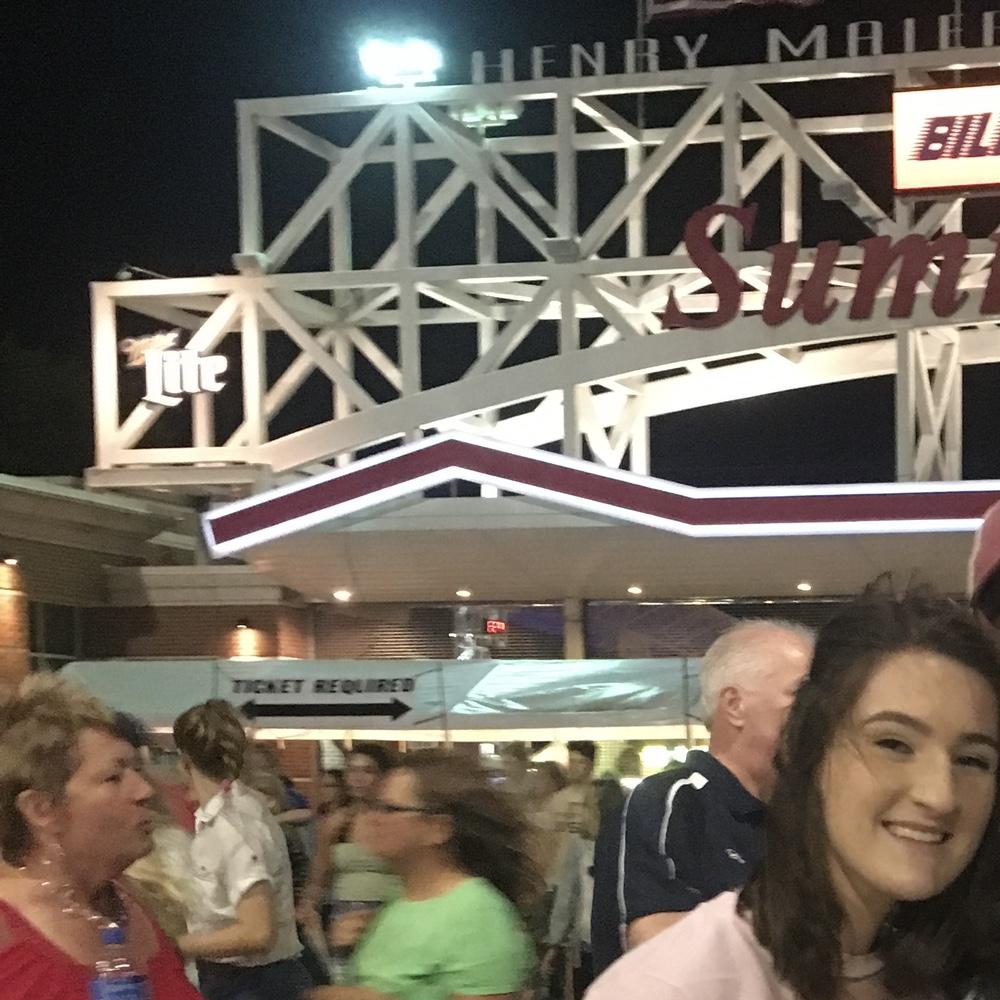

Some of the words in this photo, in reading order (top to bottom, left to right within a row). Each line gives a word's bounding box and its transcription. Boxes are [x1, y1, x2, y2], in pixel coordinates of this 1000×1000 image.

[471, 33, 708, 84] HENRY
[141, 349, 228, 407] Lite
[232, 679, 305, 694] TICKET
[312, 678, 416, 695] REQUIRED
